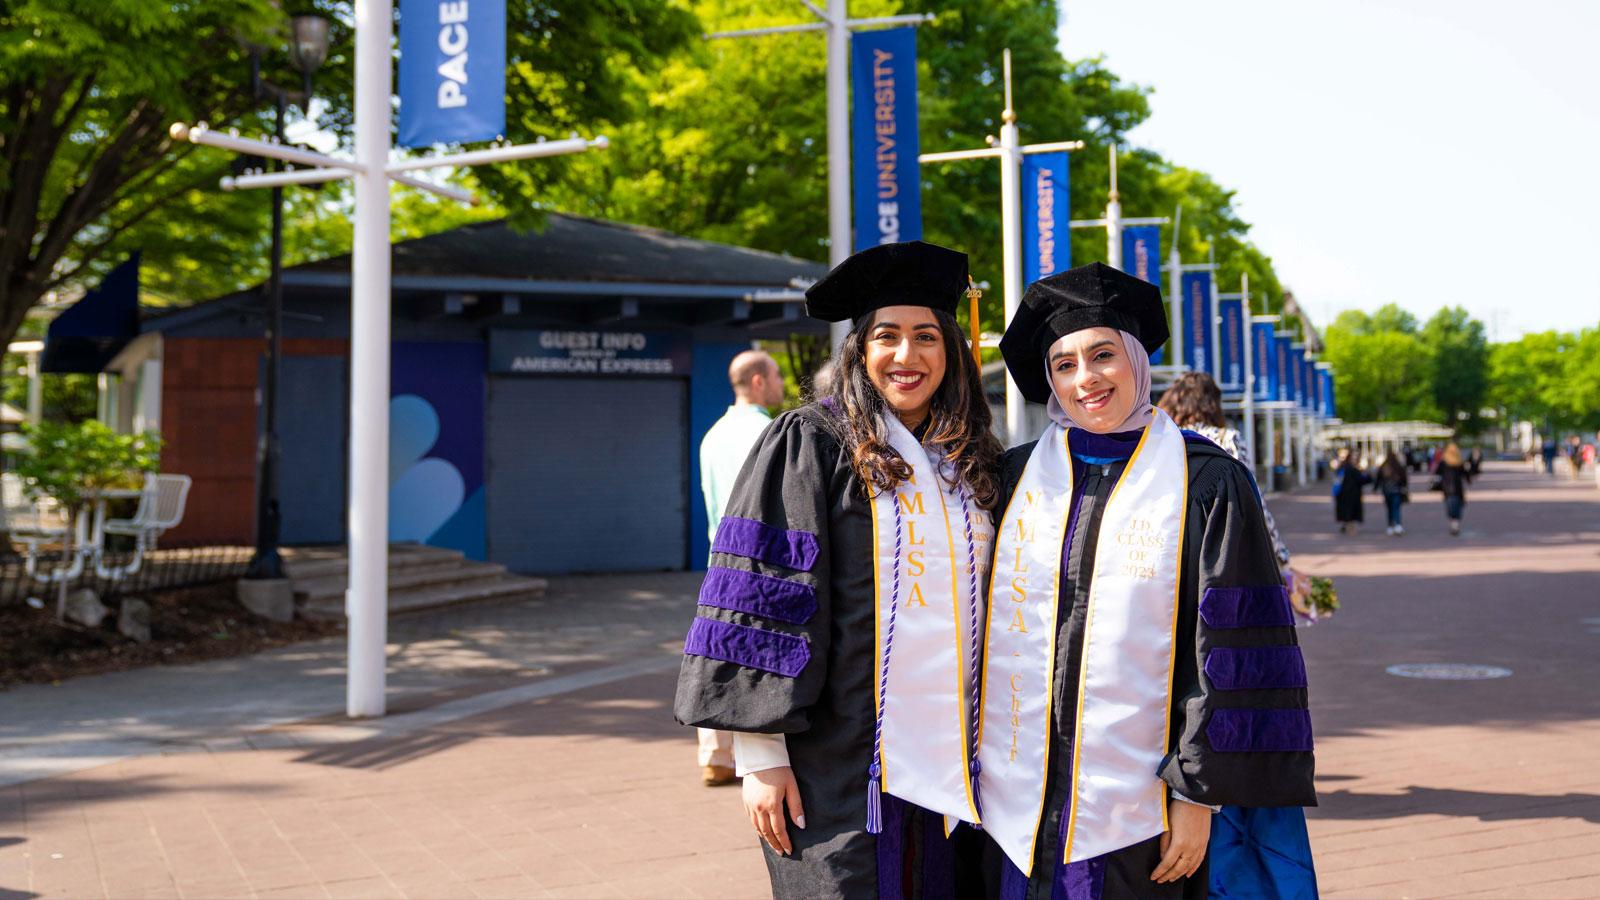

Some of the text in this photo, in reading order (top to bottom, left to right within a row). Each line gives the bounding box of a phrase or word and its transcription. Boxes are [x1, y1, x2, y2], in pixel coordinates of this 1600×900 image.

[437, 1, 469, 109] PACE
[872, 48, 900, 245] ACE UNIVERSITY
[511, 356, 674, 374] AMERICAN EXPRESS
[539, 330, 647, 351] GUEST INFO
